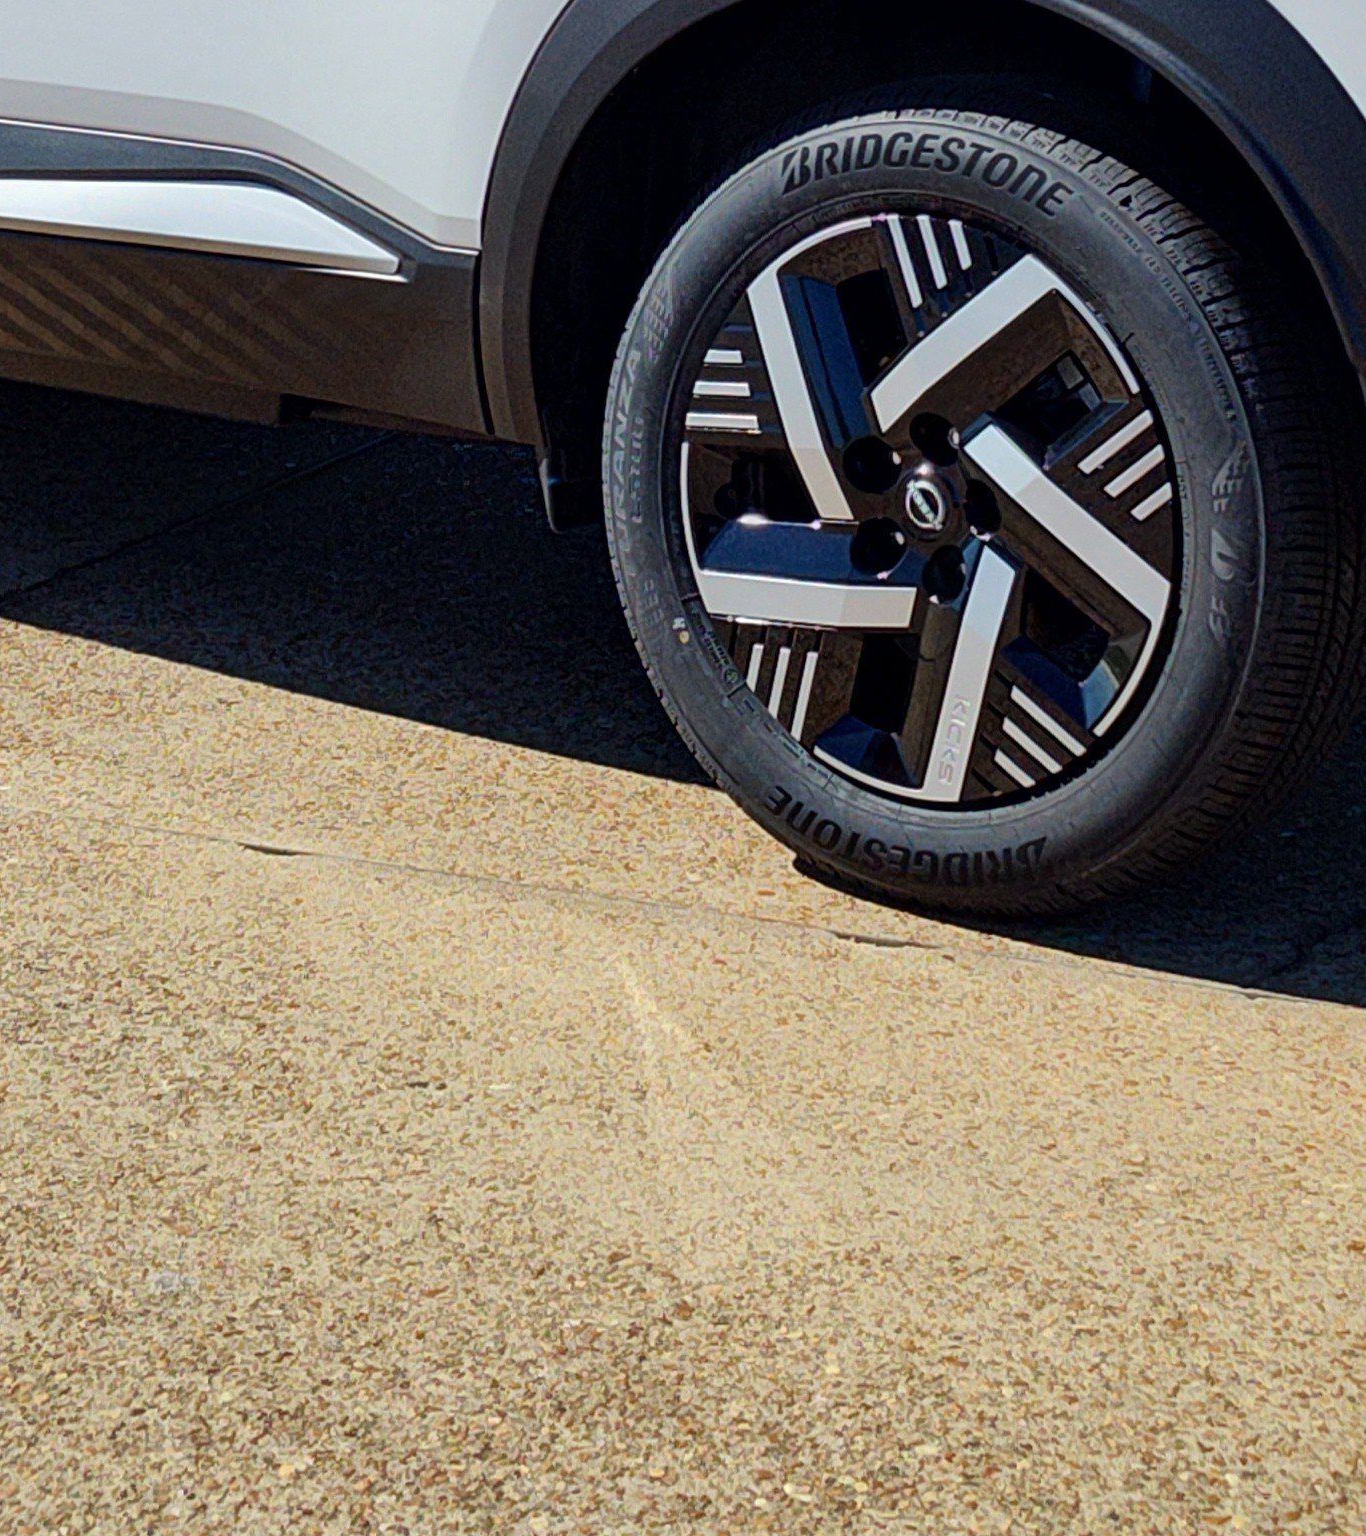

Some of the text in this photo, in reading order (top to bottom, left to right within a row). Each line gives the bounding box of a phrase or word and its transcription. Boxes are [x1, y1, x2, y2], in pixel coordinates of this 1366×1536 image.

[781, 131, 1074, 217] BRIDGESTONE
[937, 694, 971, 785] KICKS
[764, 785, 1048, 886] BRIDGESTONE
